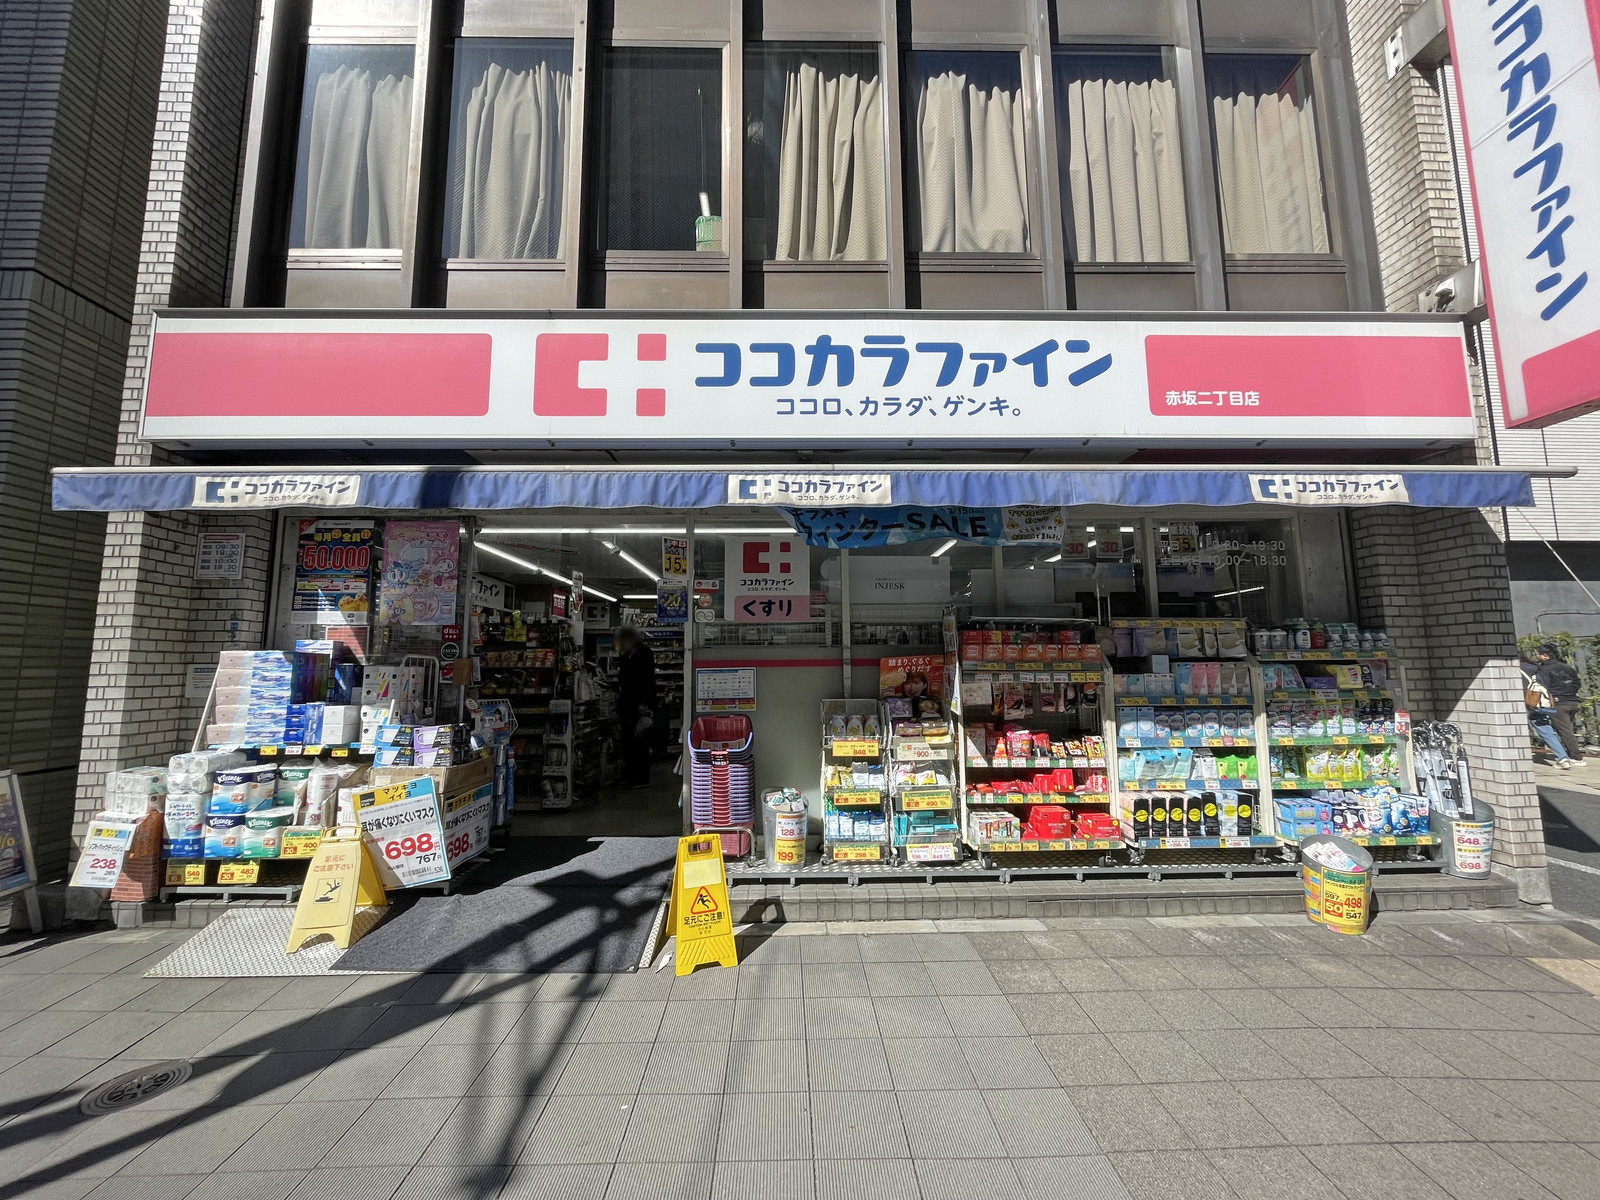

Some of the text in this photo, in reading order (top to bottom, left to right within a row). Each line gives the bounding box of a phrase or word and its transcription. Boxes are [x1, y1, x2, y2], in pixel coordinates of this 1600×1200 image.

[694, 334, 1113, 388] ココカラファイン
[1165, 390, 1260, 406] 赤坂二丁目店
[776, 396, 1021, 417] ココロ、カラダ、ゲンキ。
[244, 480, 351, 495] ココカラファイン
[778, 479, 882, 493] ココカラファイン
[1296, 479, 1399, 493] ココカラファイン
[740, 578, 795, 586] ココカラファイン
[874, 582, 905, 590] INJESK
[742, 599, 792, 617] くすり
[217, 774, 243, 784] Kleenex
[209, 817, 234, 826] Kleenex
[248, 817, 273, 828] Kleenex
[780, 828, 795, 836] 128
[1456, 836, 1480, 845] 648
[777, 851, 794, 861] 199
[89, 858, 117, 870] 238
[1460, 861, 1481, 870] 698
[1326, 902, 1343, 914] 50
[1344, 897, 1362, 909] 498
